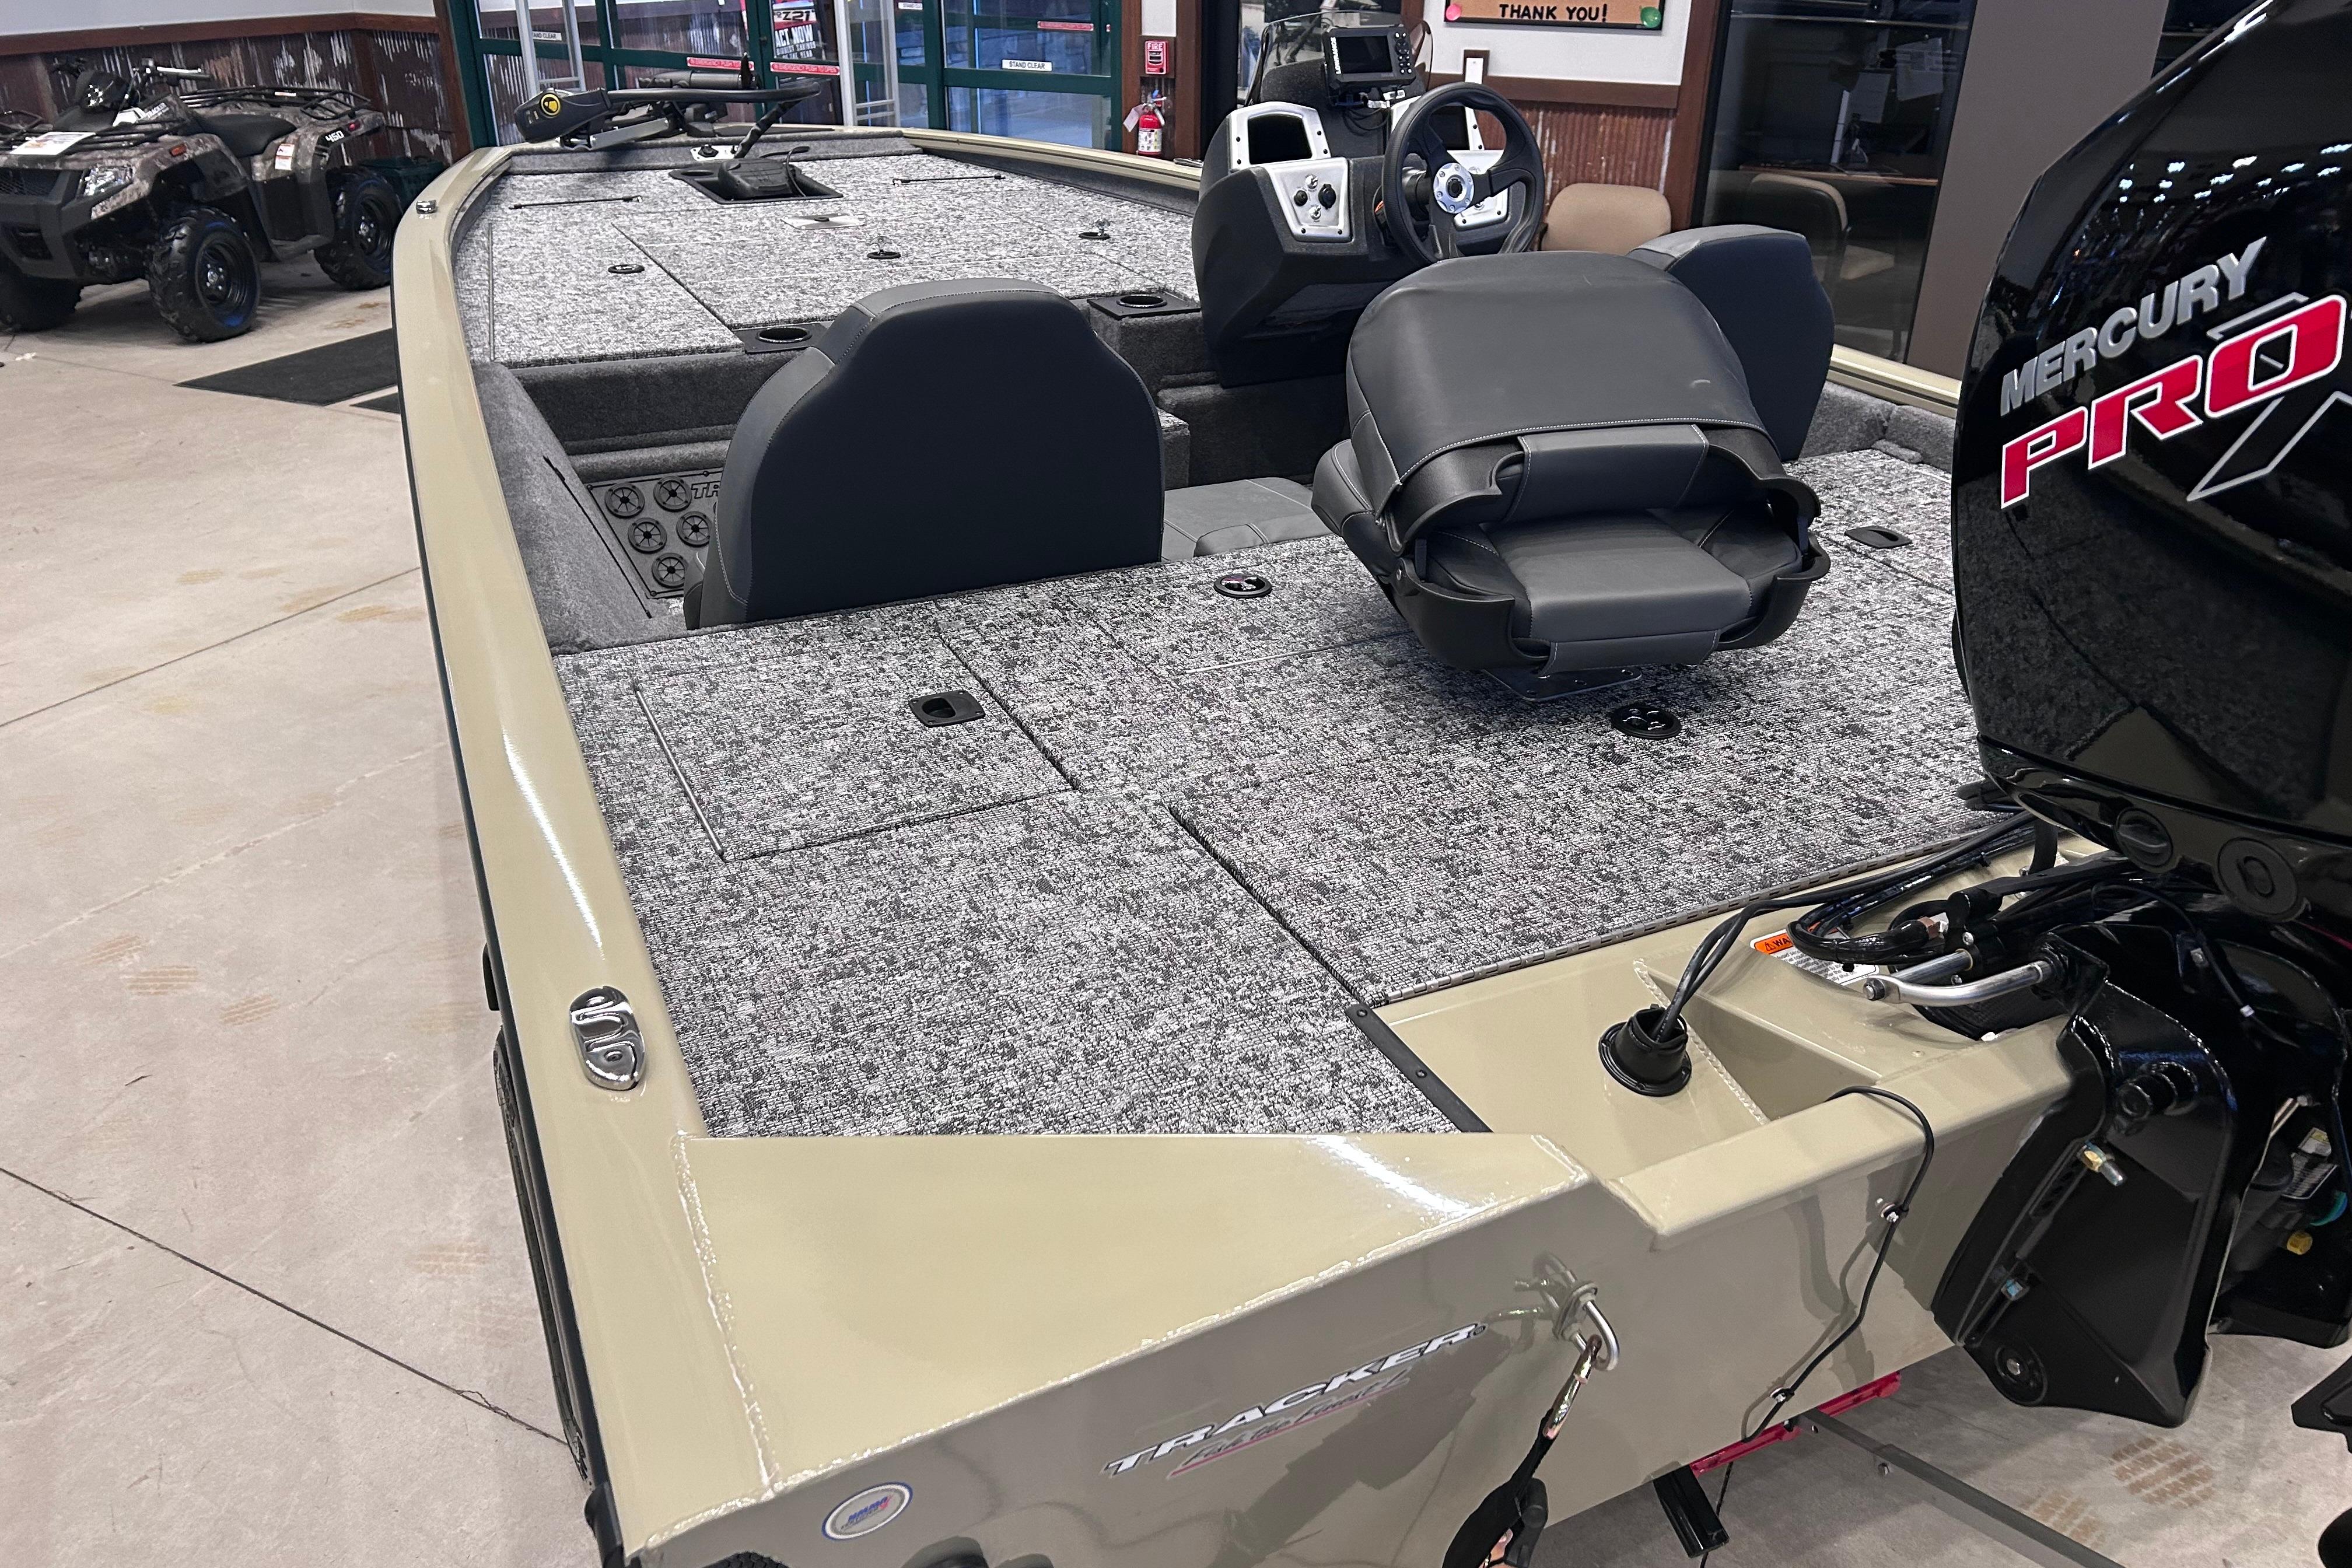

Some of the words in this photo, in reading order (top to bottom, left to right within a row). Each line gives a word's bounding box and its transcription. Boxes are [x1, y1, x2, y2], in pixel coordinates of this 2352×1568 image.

[782, 10, 811, 21] Z21
[1499, 4, 1557, 19] THANK
[1566, 4, 1608, 22] YOU!
[775, 28, 790, 48] ACT
[791, 24, 814, 44] NOW
[1147, 43, 1163, 51] FIRE
[1330, 37, 1342, 74] LOWRANCE
[325, 130, 345, 142] 450
[2000, 236, 2267, 416] MERCURY
[2001, 295, 2347, 509] PRO
